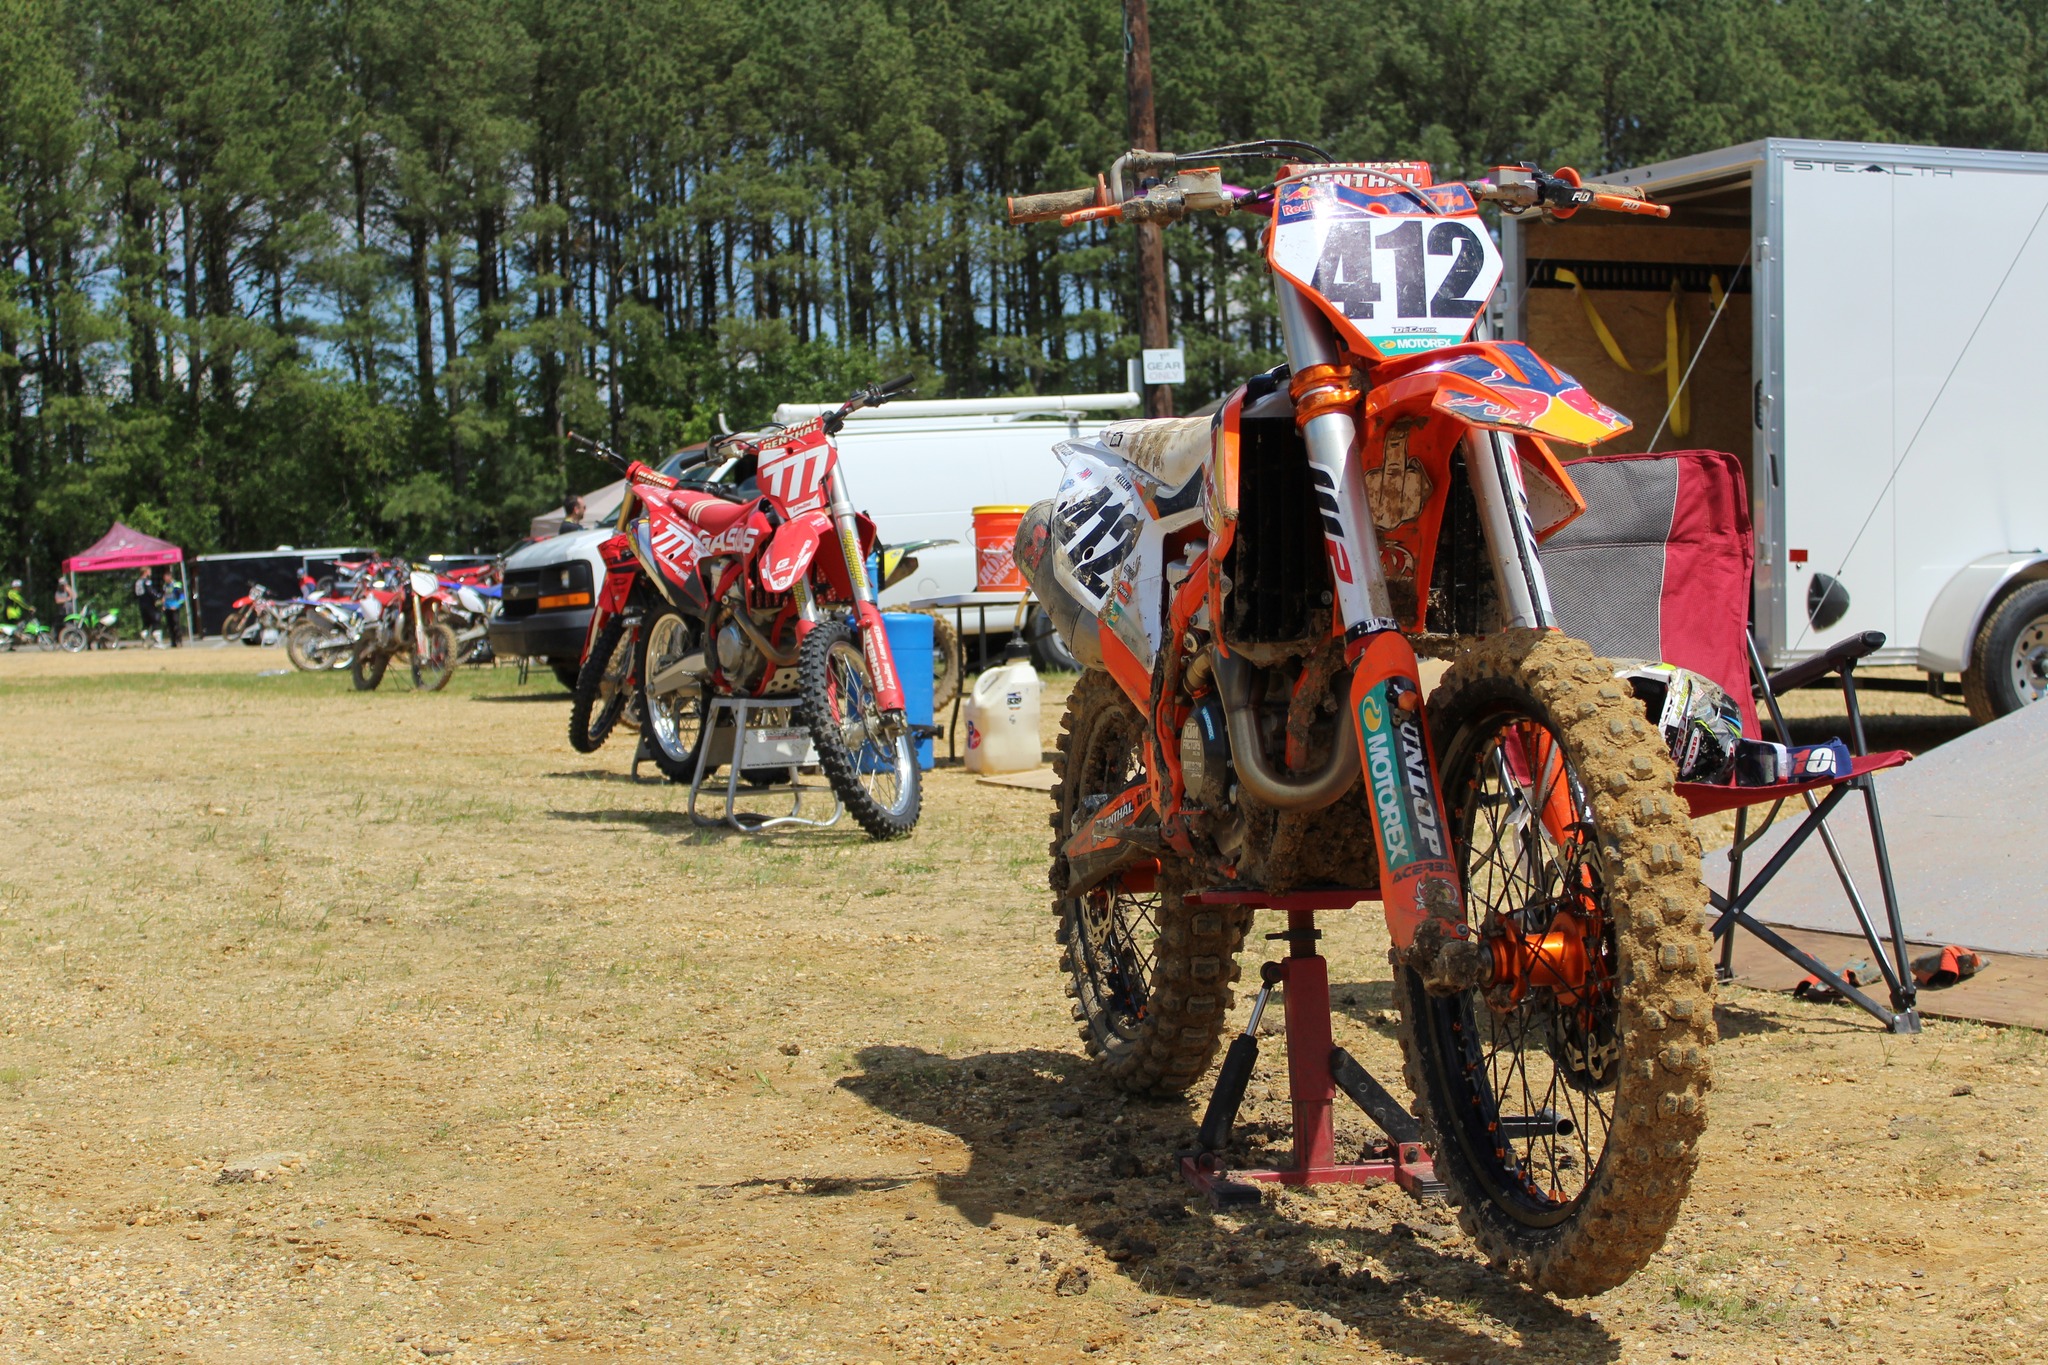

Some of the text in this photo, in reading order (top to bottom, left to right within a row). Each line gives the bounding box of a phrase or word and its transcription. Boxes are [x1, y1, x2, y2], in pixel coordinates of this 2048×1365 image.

[1302, 173, 1421, 187] RENTHAL
[1282, 203, 1311, 217] Red
[1311, 220, 1485, 319] 412
[1397, 338, 1452, 348] MOTOREX
[1147, 361, 1181, 370] GEAR
[763, 444, 829, 502] 777
[1115, 473, 1132, 492] KELLER
[651, 524, 692, 561] 777
[1053, 486, 1138, 599] 412
[992, 556, 1017, 586] DEPO
[1394, 684, 1442, 857] UNLOP
[1793, 747, 1837, 776] 10
[1366, 732, 1408, 864] MOTOREX
